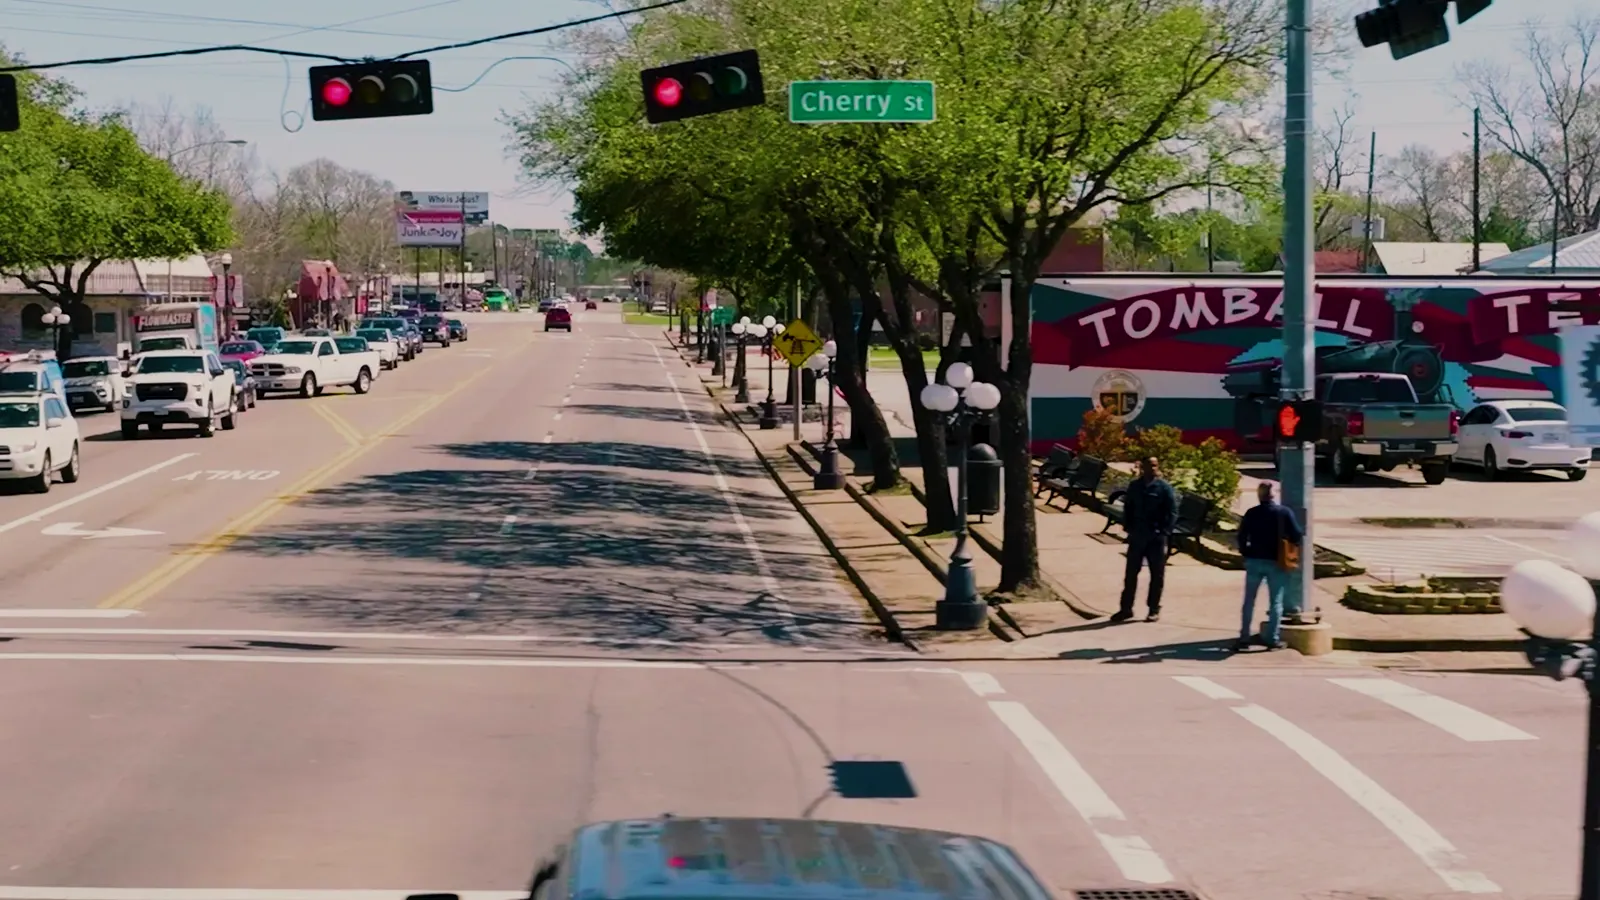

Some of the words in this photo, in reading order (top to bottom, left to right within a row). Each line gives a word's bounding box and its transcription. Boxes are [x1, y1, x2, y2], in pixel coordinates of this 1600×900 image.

[801, 90, 891, 117] Cherry
[428, 195, 445, 204] Who
[446, 195, 453, 204] is
[401, 227, 425, 238] Junk
[440, 227, 459, 240] Joy
[1493, 291, 1600, 333] TE
[172, 470, 281, 481] ONLY
